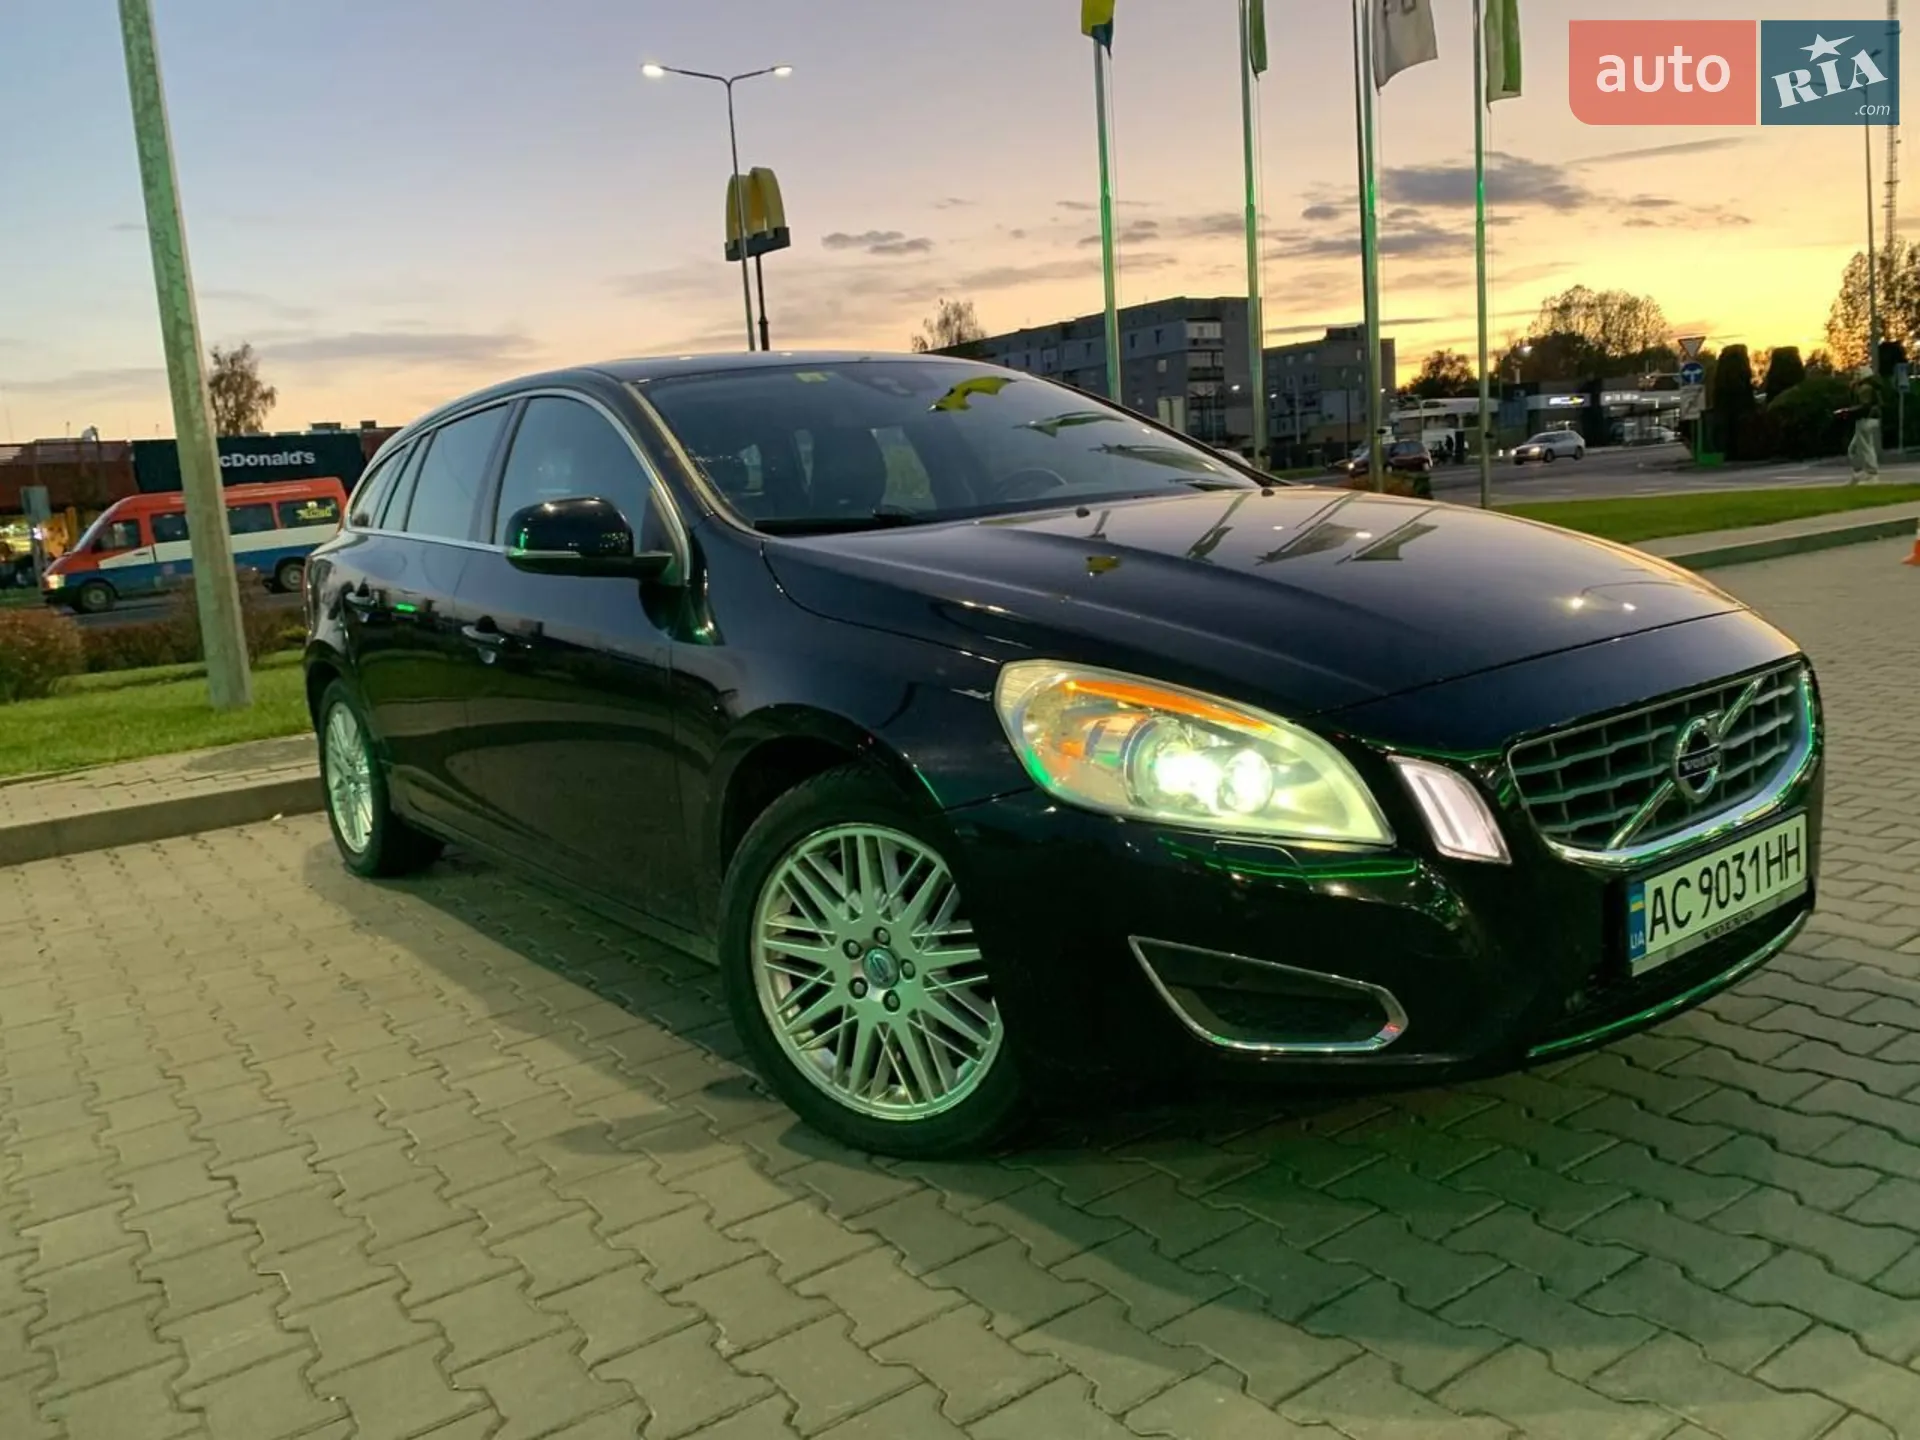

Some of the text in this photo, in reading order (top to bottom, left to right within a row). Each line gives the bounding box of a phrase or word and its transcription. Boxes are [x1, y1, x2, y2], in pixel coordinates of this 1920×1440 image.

[219, 450, 316, 468] cDonald's
[1649, 876, 1692, 943] AC
[1630, 930, 1645, 949] UA
